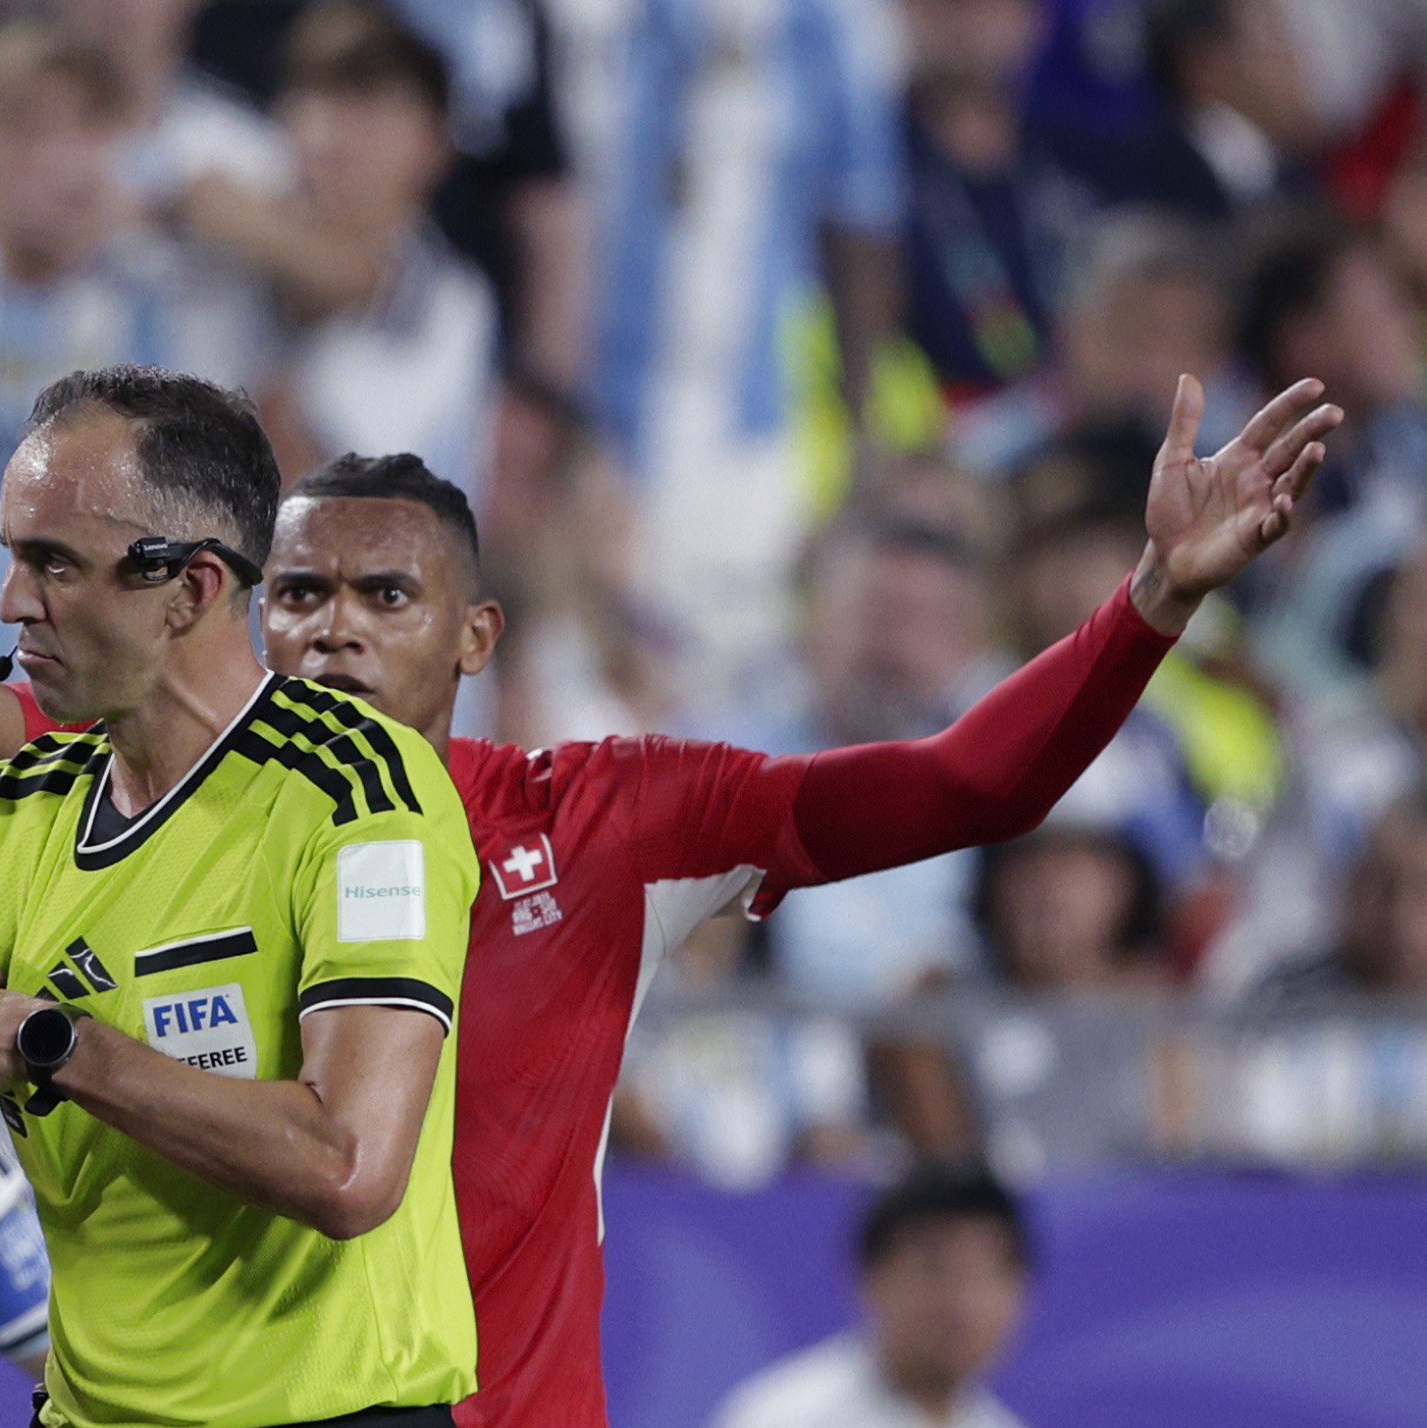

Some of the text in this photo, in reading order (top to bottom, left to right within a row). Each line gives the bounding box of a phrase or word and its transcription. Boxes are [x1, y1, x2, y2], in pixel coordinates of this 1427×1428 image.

[345, 885, 421, 899] Hisense
[153, 995, 238, 1037] FIFA
[177, 1046, 247, 1070] FEREE
